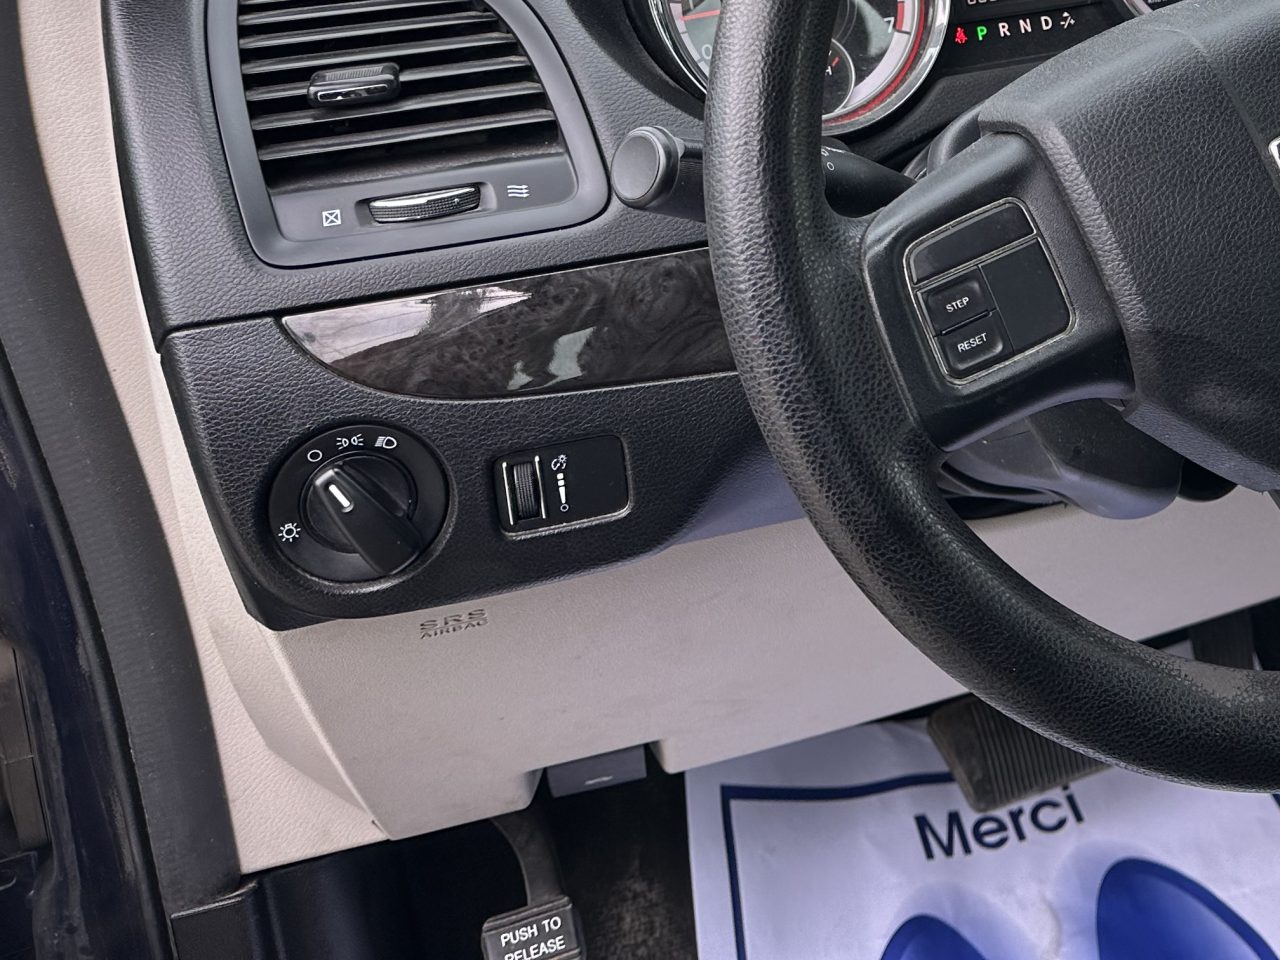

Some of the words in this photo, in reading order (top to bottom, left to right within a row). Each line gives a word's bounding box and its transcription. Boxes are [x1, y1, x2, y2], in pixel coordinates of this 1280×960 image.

[883, 16, 895, 34] 7
[701, 43, 713, 61] 0
[945, 296, 970, 313] STEP
[957, 332, 988, 353] RESET
[420, 608, 486, 630] SRS
[914, 784, 1084, 861] Merci
[500, 924, 538, 948] PUSH
[541, 916, 562, 933] TO
[504, 935, 566, 960] RELEASE
